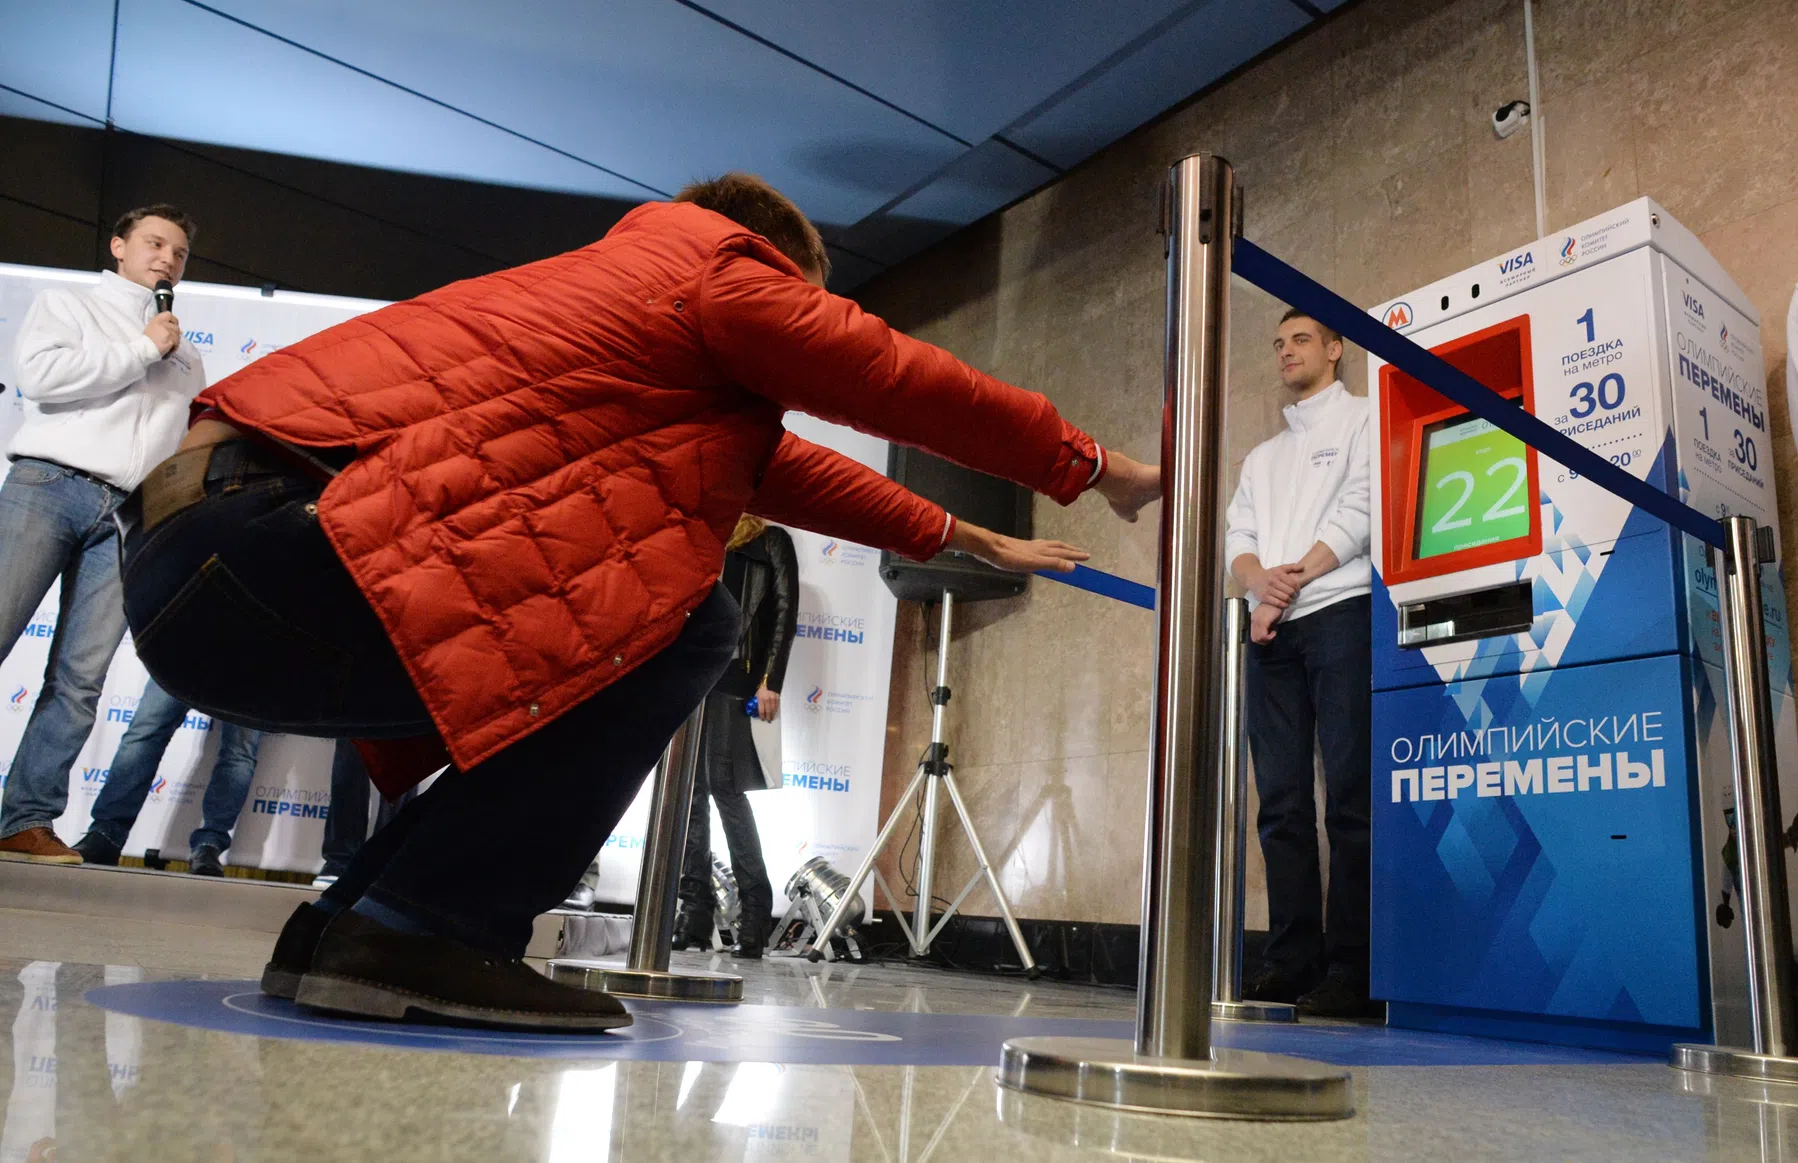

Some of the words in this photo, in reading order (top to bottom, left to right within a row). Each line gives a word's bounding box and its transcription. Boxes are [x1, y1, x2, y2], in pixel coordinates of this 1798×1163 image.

[1498, 251, 1534, 275] VISA
[1682, 290, 1705, 319] VISA
[1576, 307, 1595, 343] 1
[1561, 338, 1624, 366] ПОЕЗДКА
[1563, 364, 1579, 376] на
[1582, 351, 1623, 371] метро
[1677, 332, 1762, 407] ОЛИМПИЙСКИЕ
[1554, 414, 1568, 426] за
[1569, 372, 1626, 419] 30
[1678, 353, 1765, 433] ПЕРЕМЕНЫ
[1560, 405, 1641, 437] РИСЕДАНИЙ
[1699, 406, 1709, 441] 1
[1733, 429, 1758, 471] 30
[1557, 474, 1565, 483] с
[1432, 457, 1527, 533] 22
[796, 624, 864, 644] ЕМЕНЫ
[798, 612, 865, 629] ПИЙСКИЕ
[1391, 711, 1663, 763] ОЛИМПИЙСКИЕ
[83, 768, 111, 783] VIS
[782, 773, 850, 792] ЕМЕНЫ
[1391, 748, 1665, 803] ПЕРЕМЕНЫ
[252, 799, 329, 819] ПЕРЕМЕ
